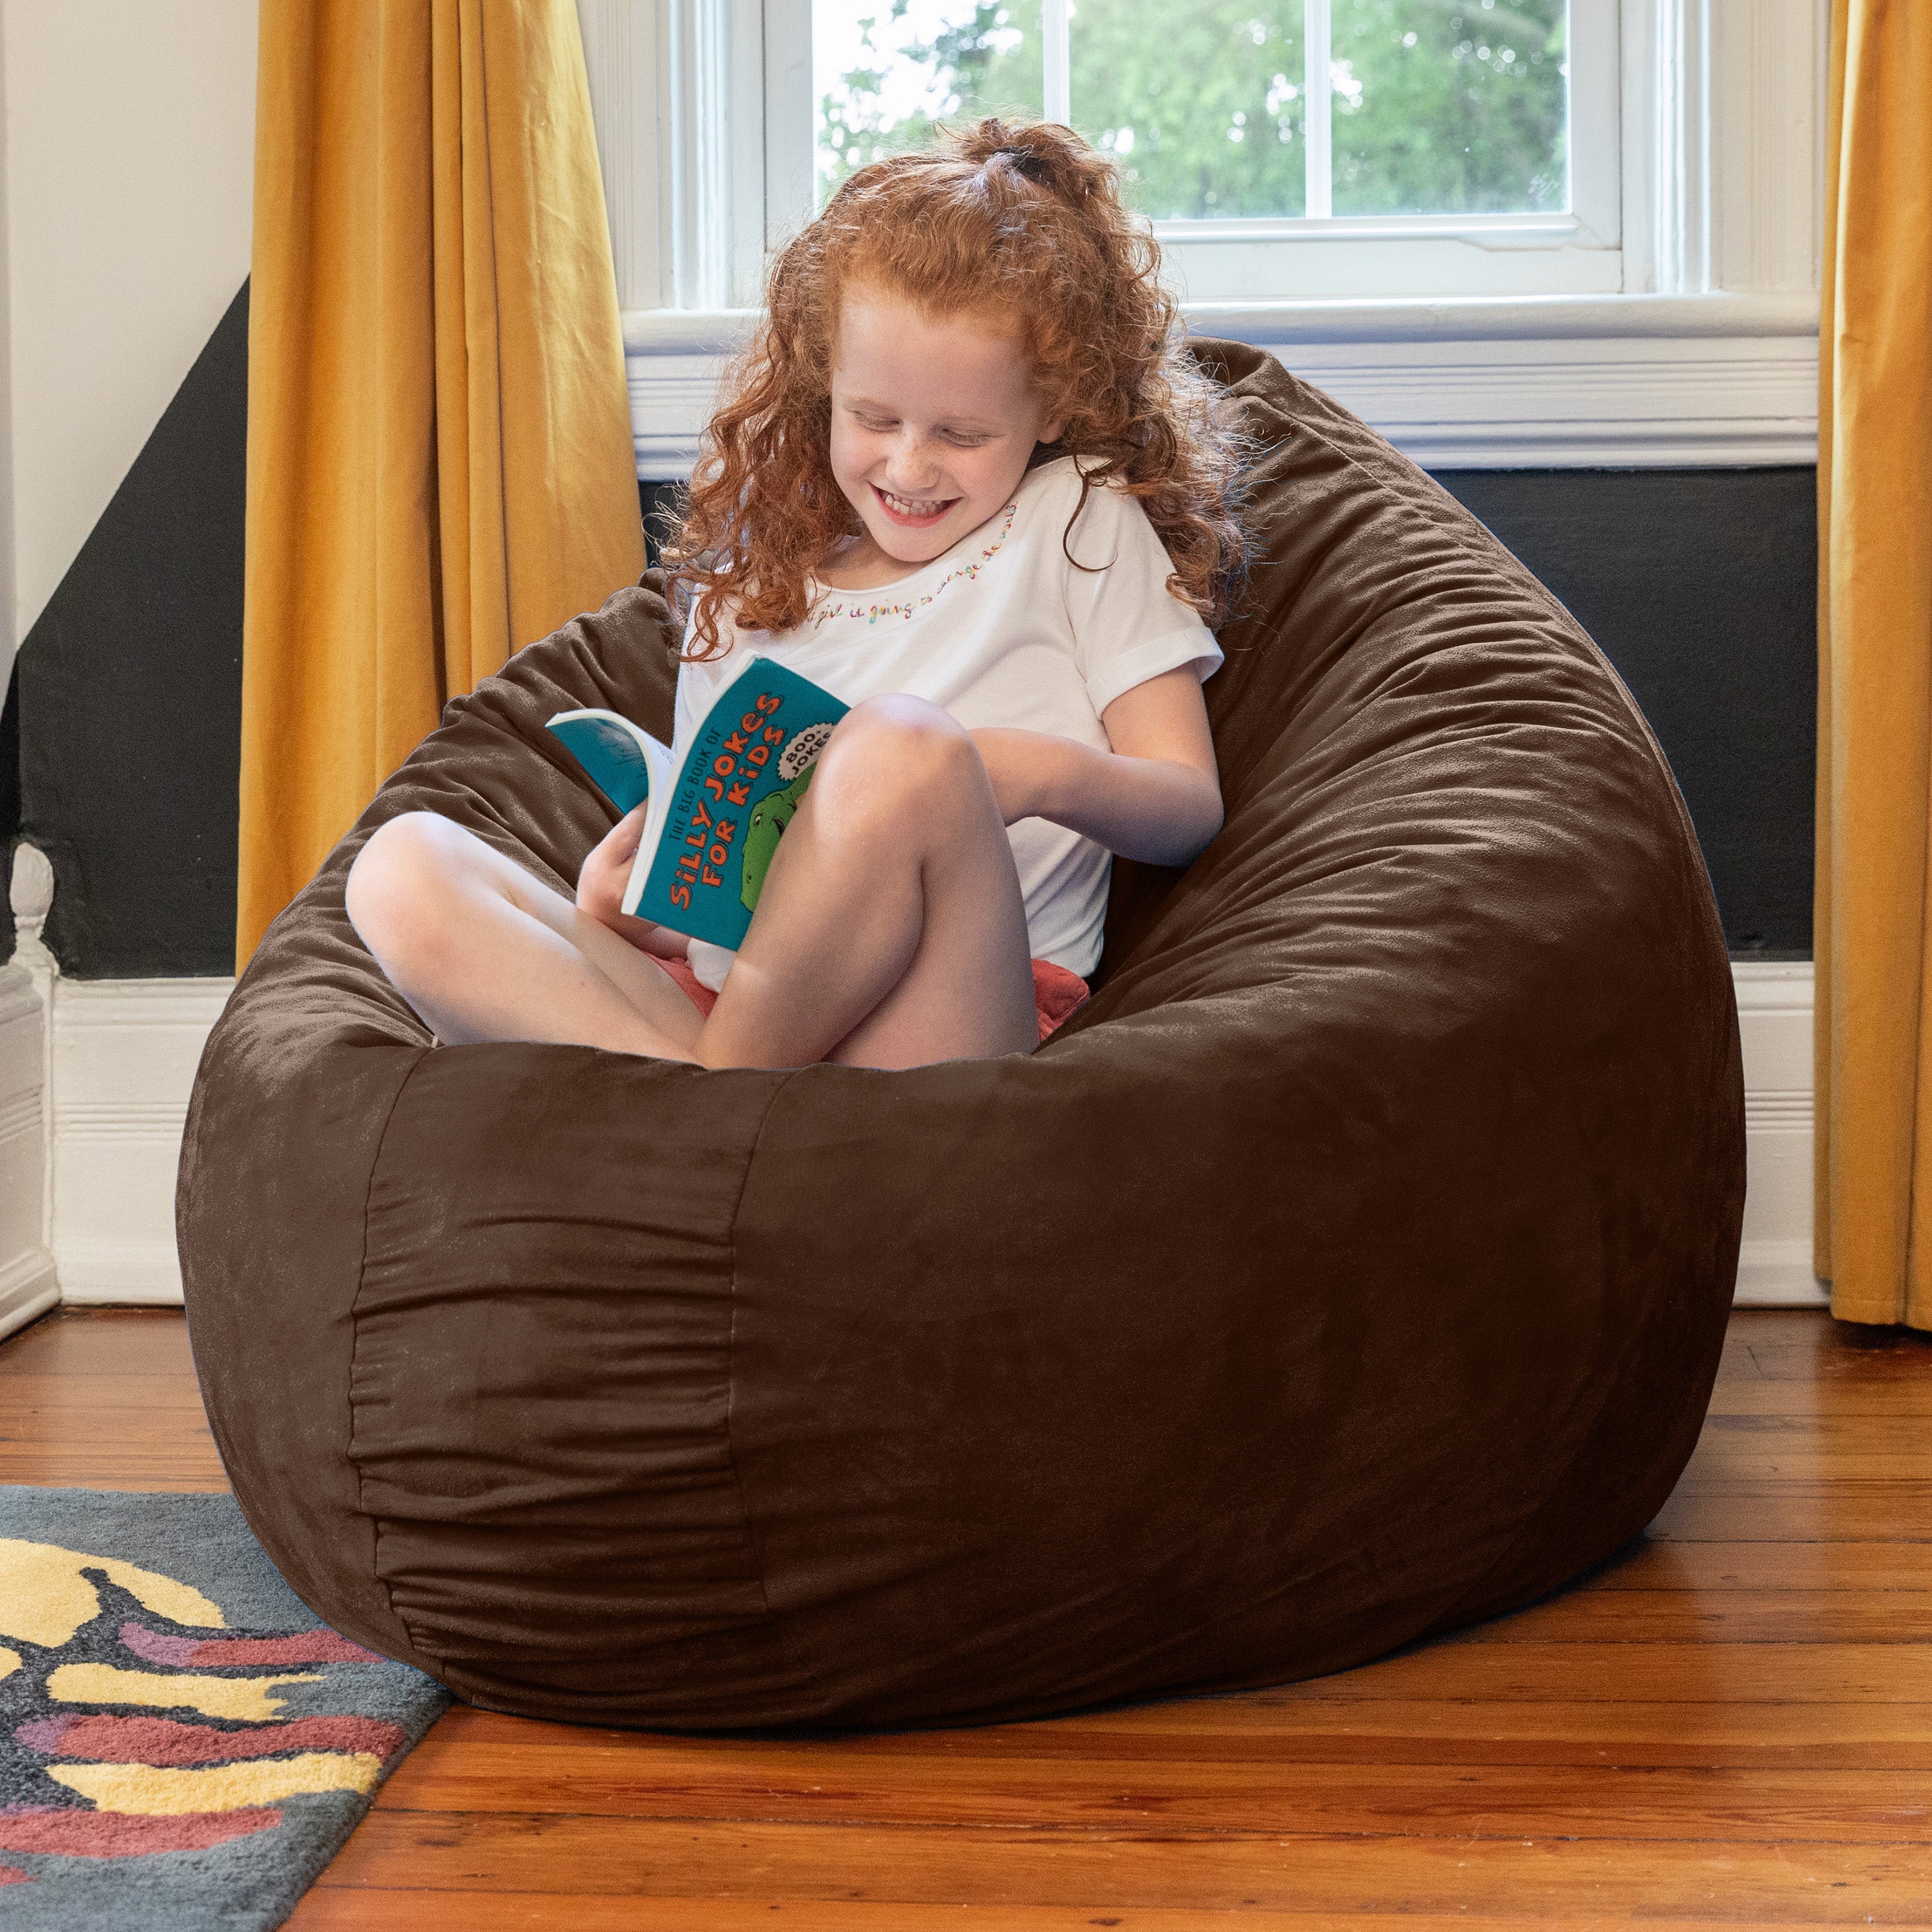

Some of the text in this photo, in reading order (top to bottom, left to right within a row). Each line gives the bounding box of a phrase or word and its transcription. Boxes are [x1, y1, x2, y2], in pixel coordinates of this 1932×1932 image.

[814, 604, 843, 629] girl
[849, 602, 864, 618] is
[869, 598, 916, 624] going
[920, 596, 933, 605] to
[936, 564, 984, 594] change
[668, 727, 721, 841] THE BIG BOOK OF
[791, 732, 831, 775] JOKES
[701, 817, 738, 888] FOR
